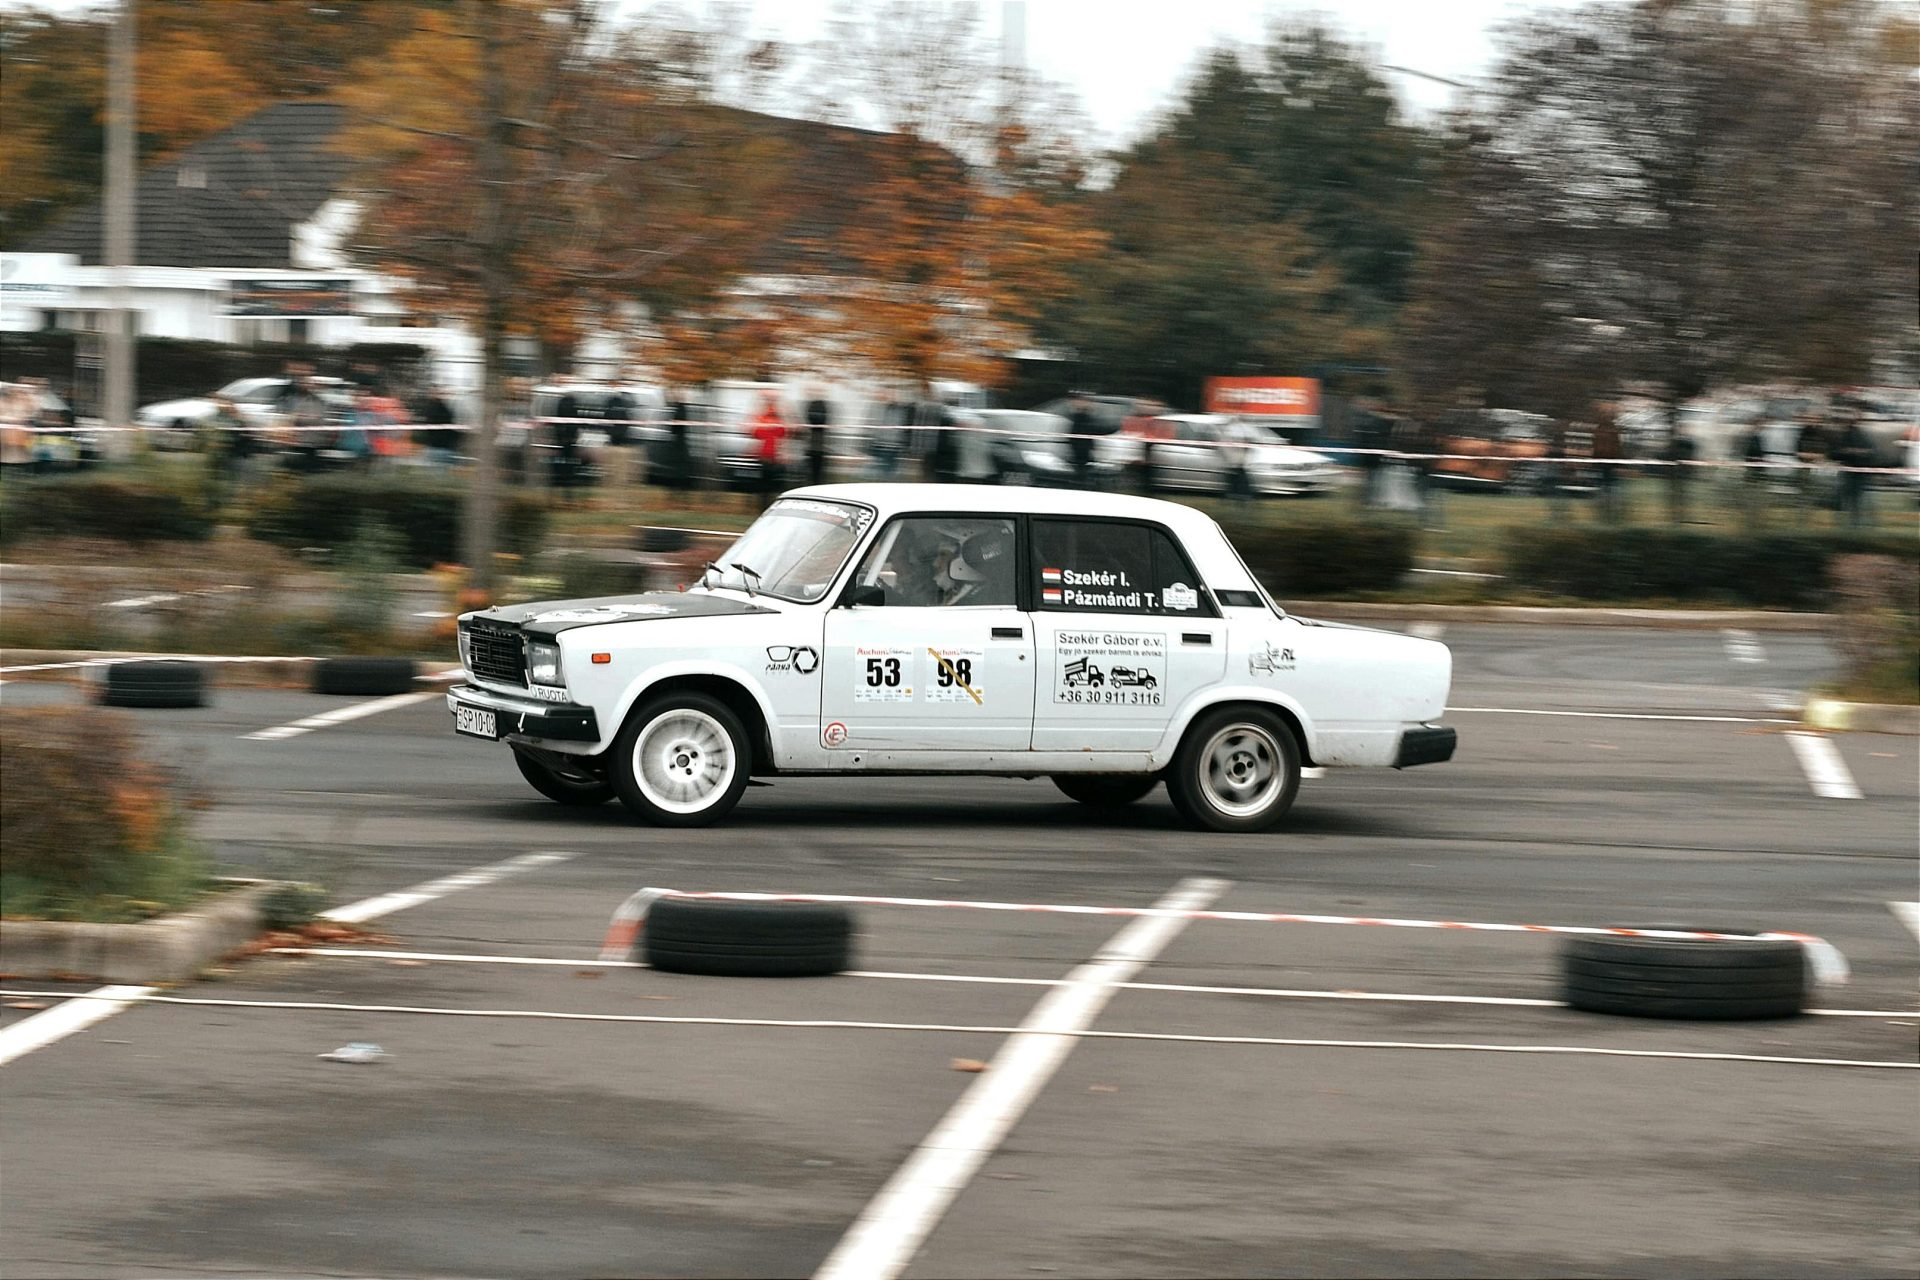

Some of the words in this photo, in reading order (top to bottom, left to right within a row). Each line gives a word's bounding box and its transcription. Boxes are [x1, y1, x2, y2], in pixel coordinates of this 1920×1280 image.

[1063, 569, 1117, 586] Szekér
[1120, 571, 1131, 587] I.
[1064, 589, 1141, 607] Pázmándi
[1144, 592, 1159, 608] T.
[1059, 633, 1100, 645] Szekér
[1103, 634, 1140, 646] Gábor
[1143, 638, 1163, 647] e.v.
[867, 658, 901, 687] 53
[937, 658, 972, 688] 98
[1060, 690, 1082, 702] +36
[1086, 690, 1101, 703] 30
[1105, 691, 1126, 704] 911
[1130, 692, 1160, 705] 3116
